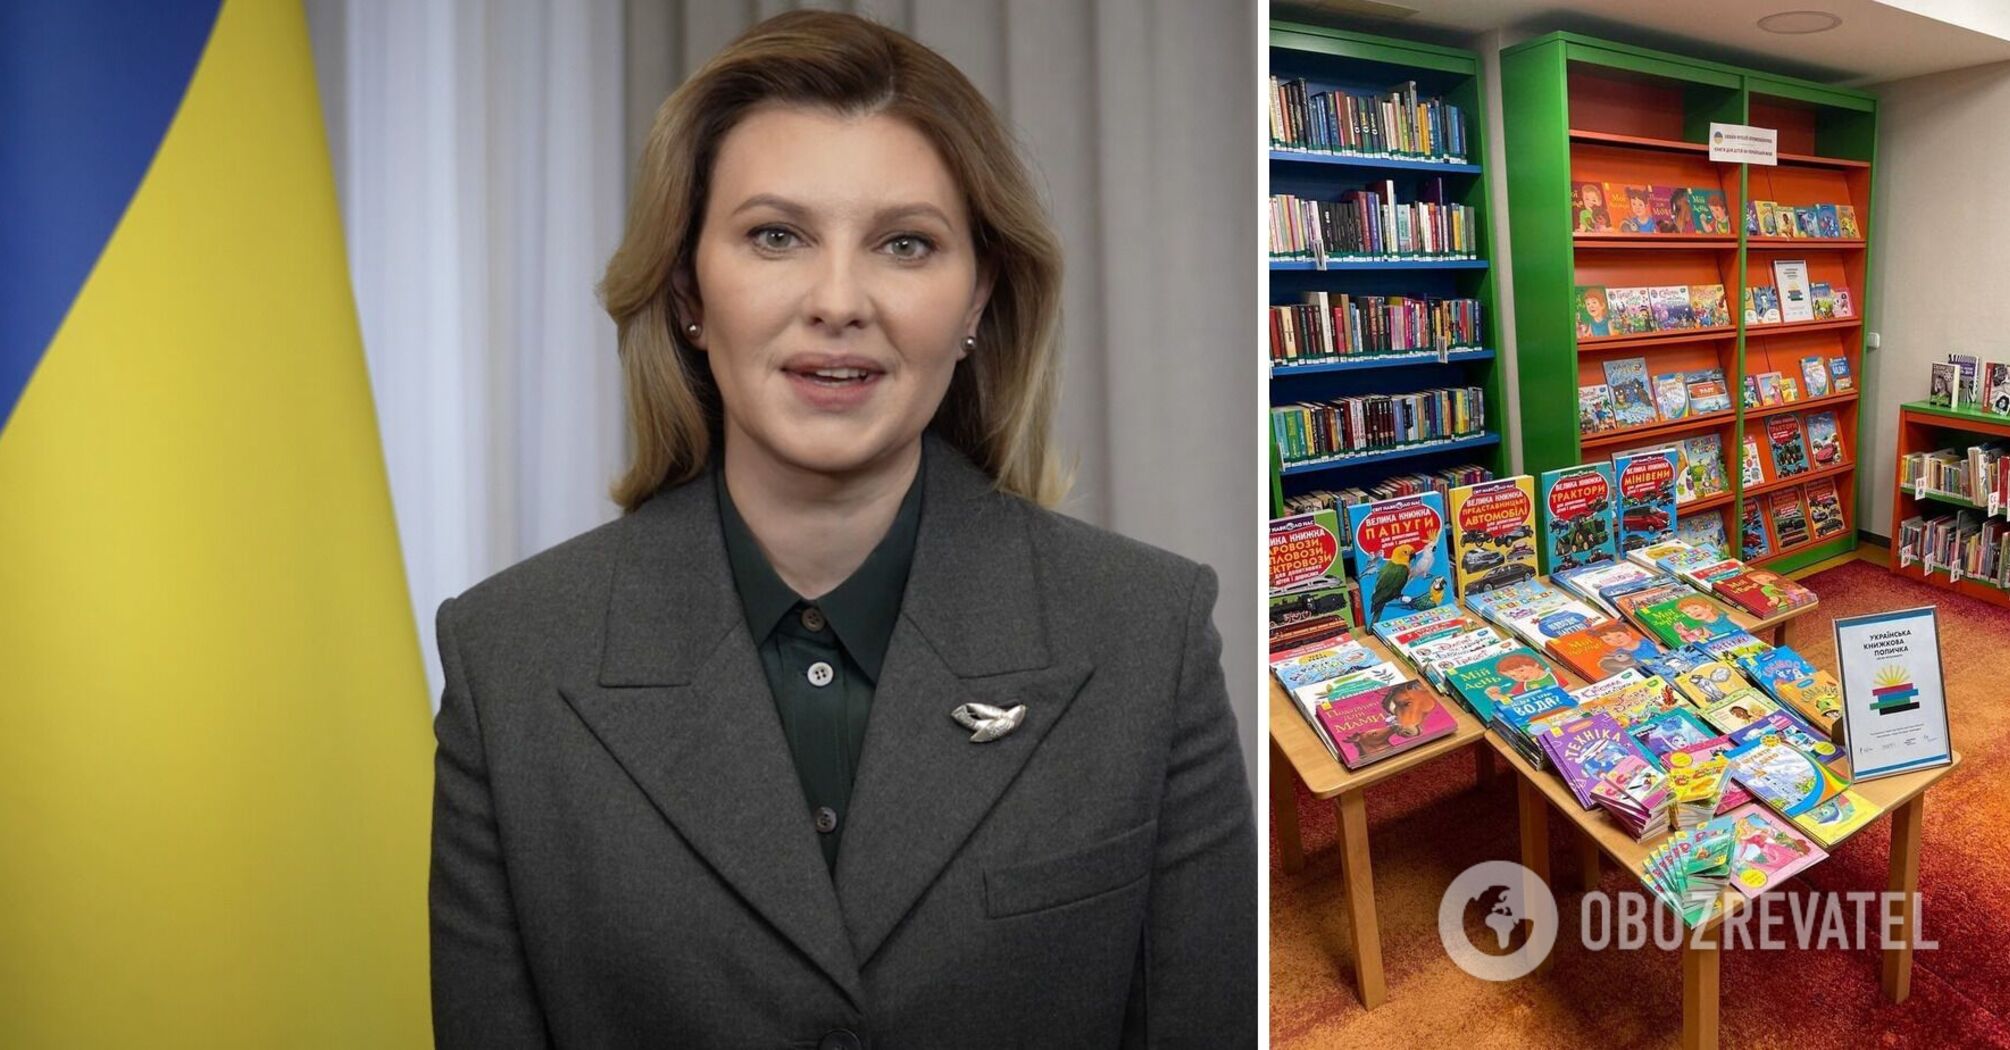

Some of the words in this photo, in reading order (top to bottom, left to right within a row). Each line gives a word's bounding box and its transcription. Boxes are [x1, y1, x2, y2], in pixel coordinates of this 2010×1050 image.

[1624, 469, 1671, 485] МІНІВЕНИ
[1551, 484, 1606, 501] ТРАКТОРИ
[1366, 514, 1397, 527] ВЕЛИКА
[1399, 508, 1432, 520] КНИЖКА
[1465, 505, 1528, 527] АВТОМОБІЛІ
[1289, 529, 1326, 542] КНИЖКА
[1366, 517, 1434, 540] ПАПУГИ
[1869, 629, 1912, 641] УКРАЇНСЬКА
[1863, 639, 1905, 650] КНИЖКОВА
[1874, 646, 1909, 657] ПОЛИЧКА
[1514, 696, 1562, 716] ВОДА?
[1565, 729, 1621, 761] ТЕХНІКА
